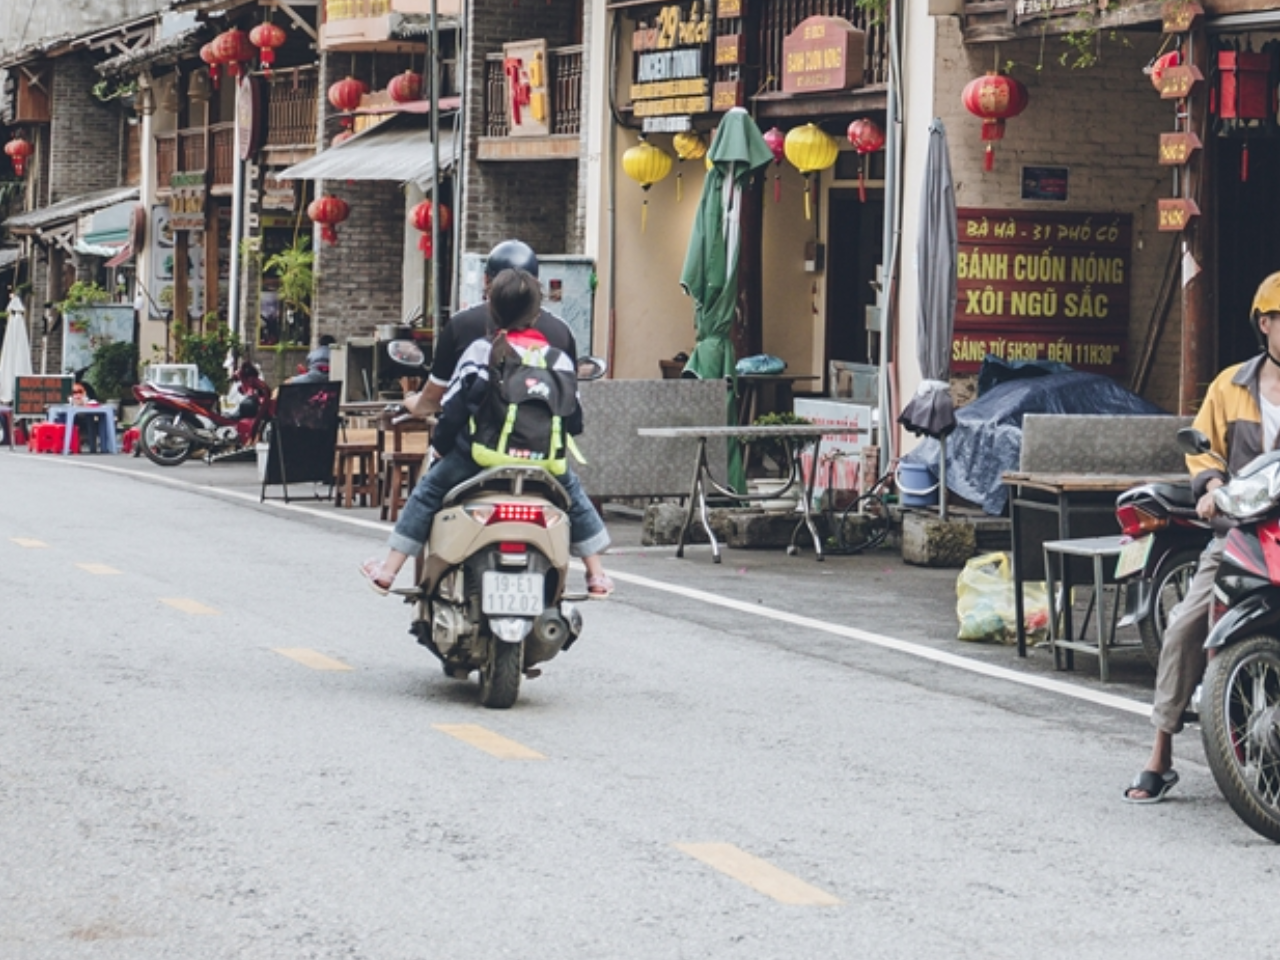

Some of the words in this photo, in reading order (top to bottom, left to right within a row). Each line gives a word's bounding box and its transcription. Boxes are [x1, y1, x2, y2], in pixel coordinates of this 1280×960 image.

[966, 215, 989, 237] BÀ
[994, 217, 1017, 238] HÀ
[1057, 216, 1092, 240] PHỐ
[957, 247, 1008, 280] BÁNH
[1014, 246, 1066, 282] CUỐN
[1071, 251, 1124, 284] NÓNG
[965, 285, 1004, 315] XÔI
[1010, 287, 1058, 316] NGŨ
[1064, 285, 1109, 318] SẮC
[952, 335, 987, 362] SÁNG
